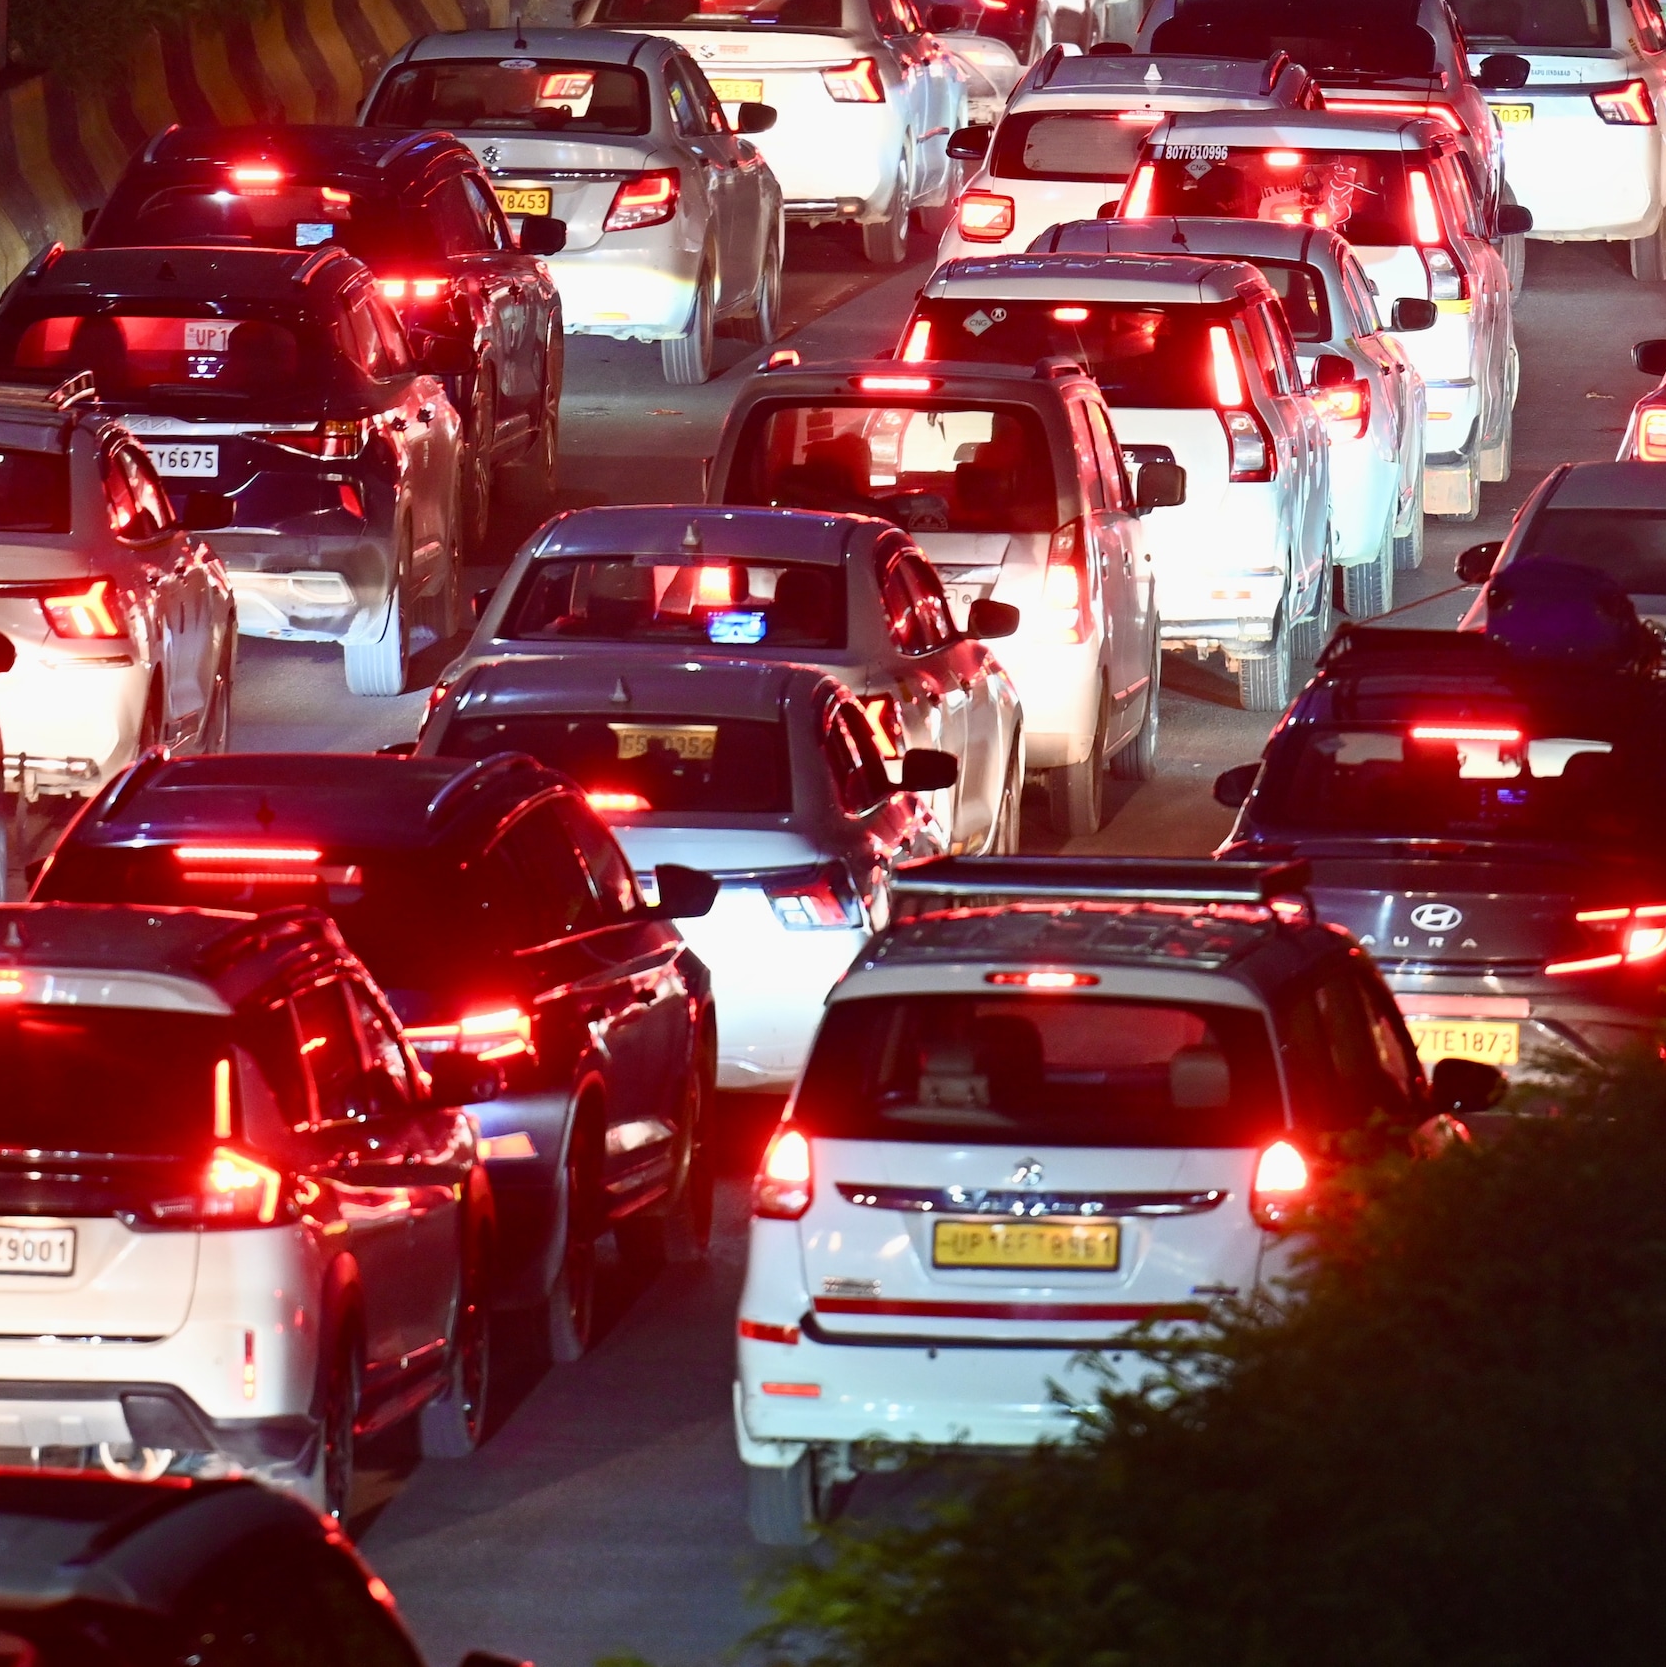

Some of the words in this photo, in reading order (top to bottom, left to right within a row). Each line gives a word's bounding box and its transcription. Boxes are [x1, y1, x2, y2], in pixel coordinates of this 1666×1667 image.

[1165, 145, 1229, 161] 8077810996
[1190, 163, 1207, 172] CNG
[969, 319, 988, 327] CNG
[1358, 934, 1479, 949] AURA
